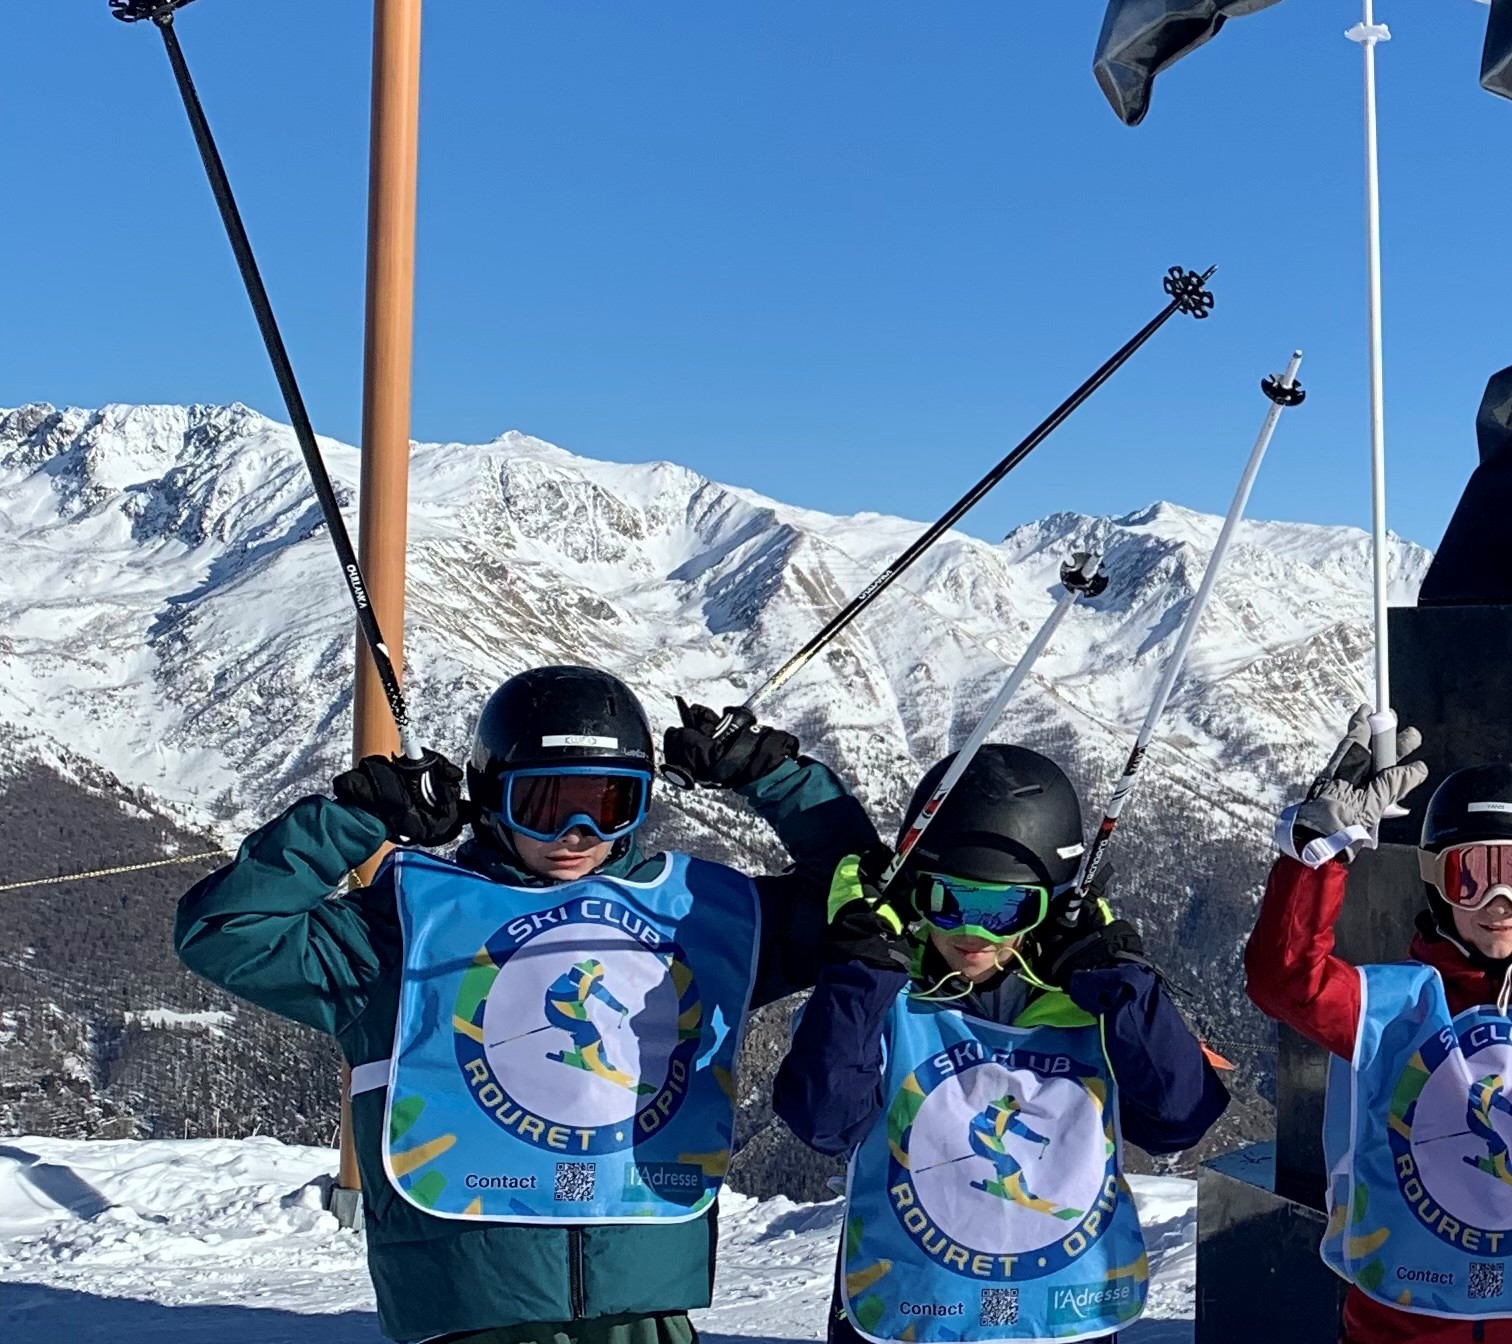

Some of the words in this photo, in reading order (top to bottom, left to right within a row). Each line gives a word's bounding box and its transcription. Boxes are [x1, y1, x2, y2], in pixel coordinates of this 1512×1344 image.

[508, 906, 568, 943] SKI
[580, 900, 661, 949] CLUB
[933, 1042, 984, 1075] SKI
[464, 1058, 596, 1151] ROURET
[637, 1059, 687, 1133] OPIO
[465, 1174, 537, 1189] Contact
[630, 1166, 699, 1192] l'Adresse
[1397, 1154, 1504, 1253] ROURET
[891, 1182, 1018, 1277] ROURET
[1396, 1266, 1454, 1285] Contact
[900, 1302, 964, 1316] Contact
[1054, 1284, 1130, 1318] l'Adresse
